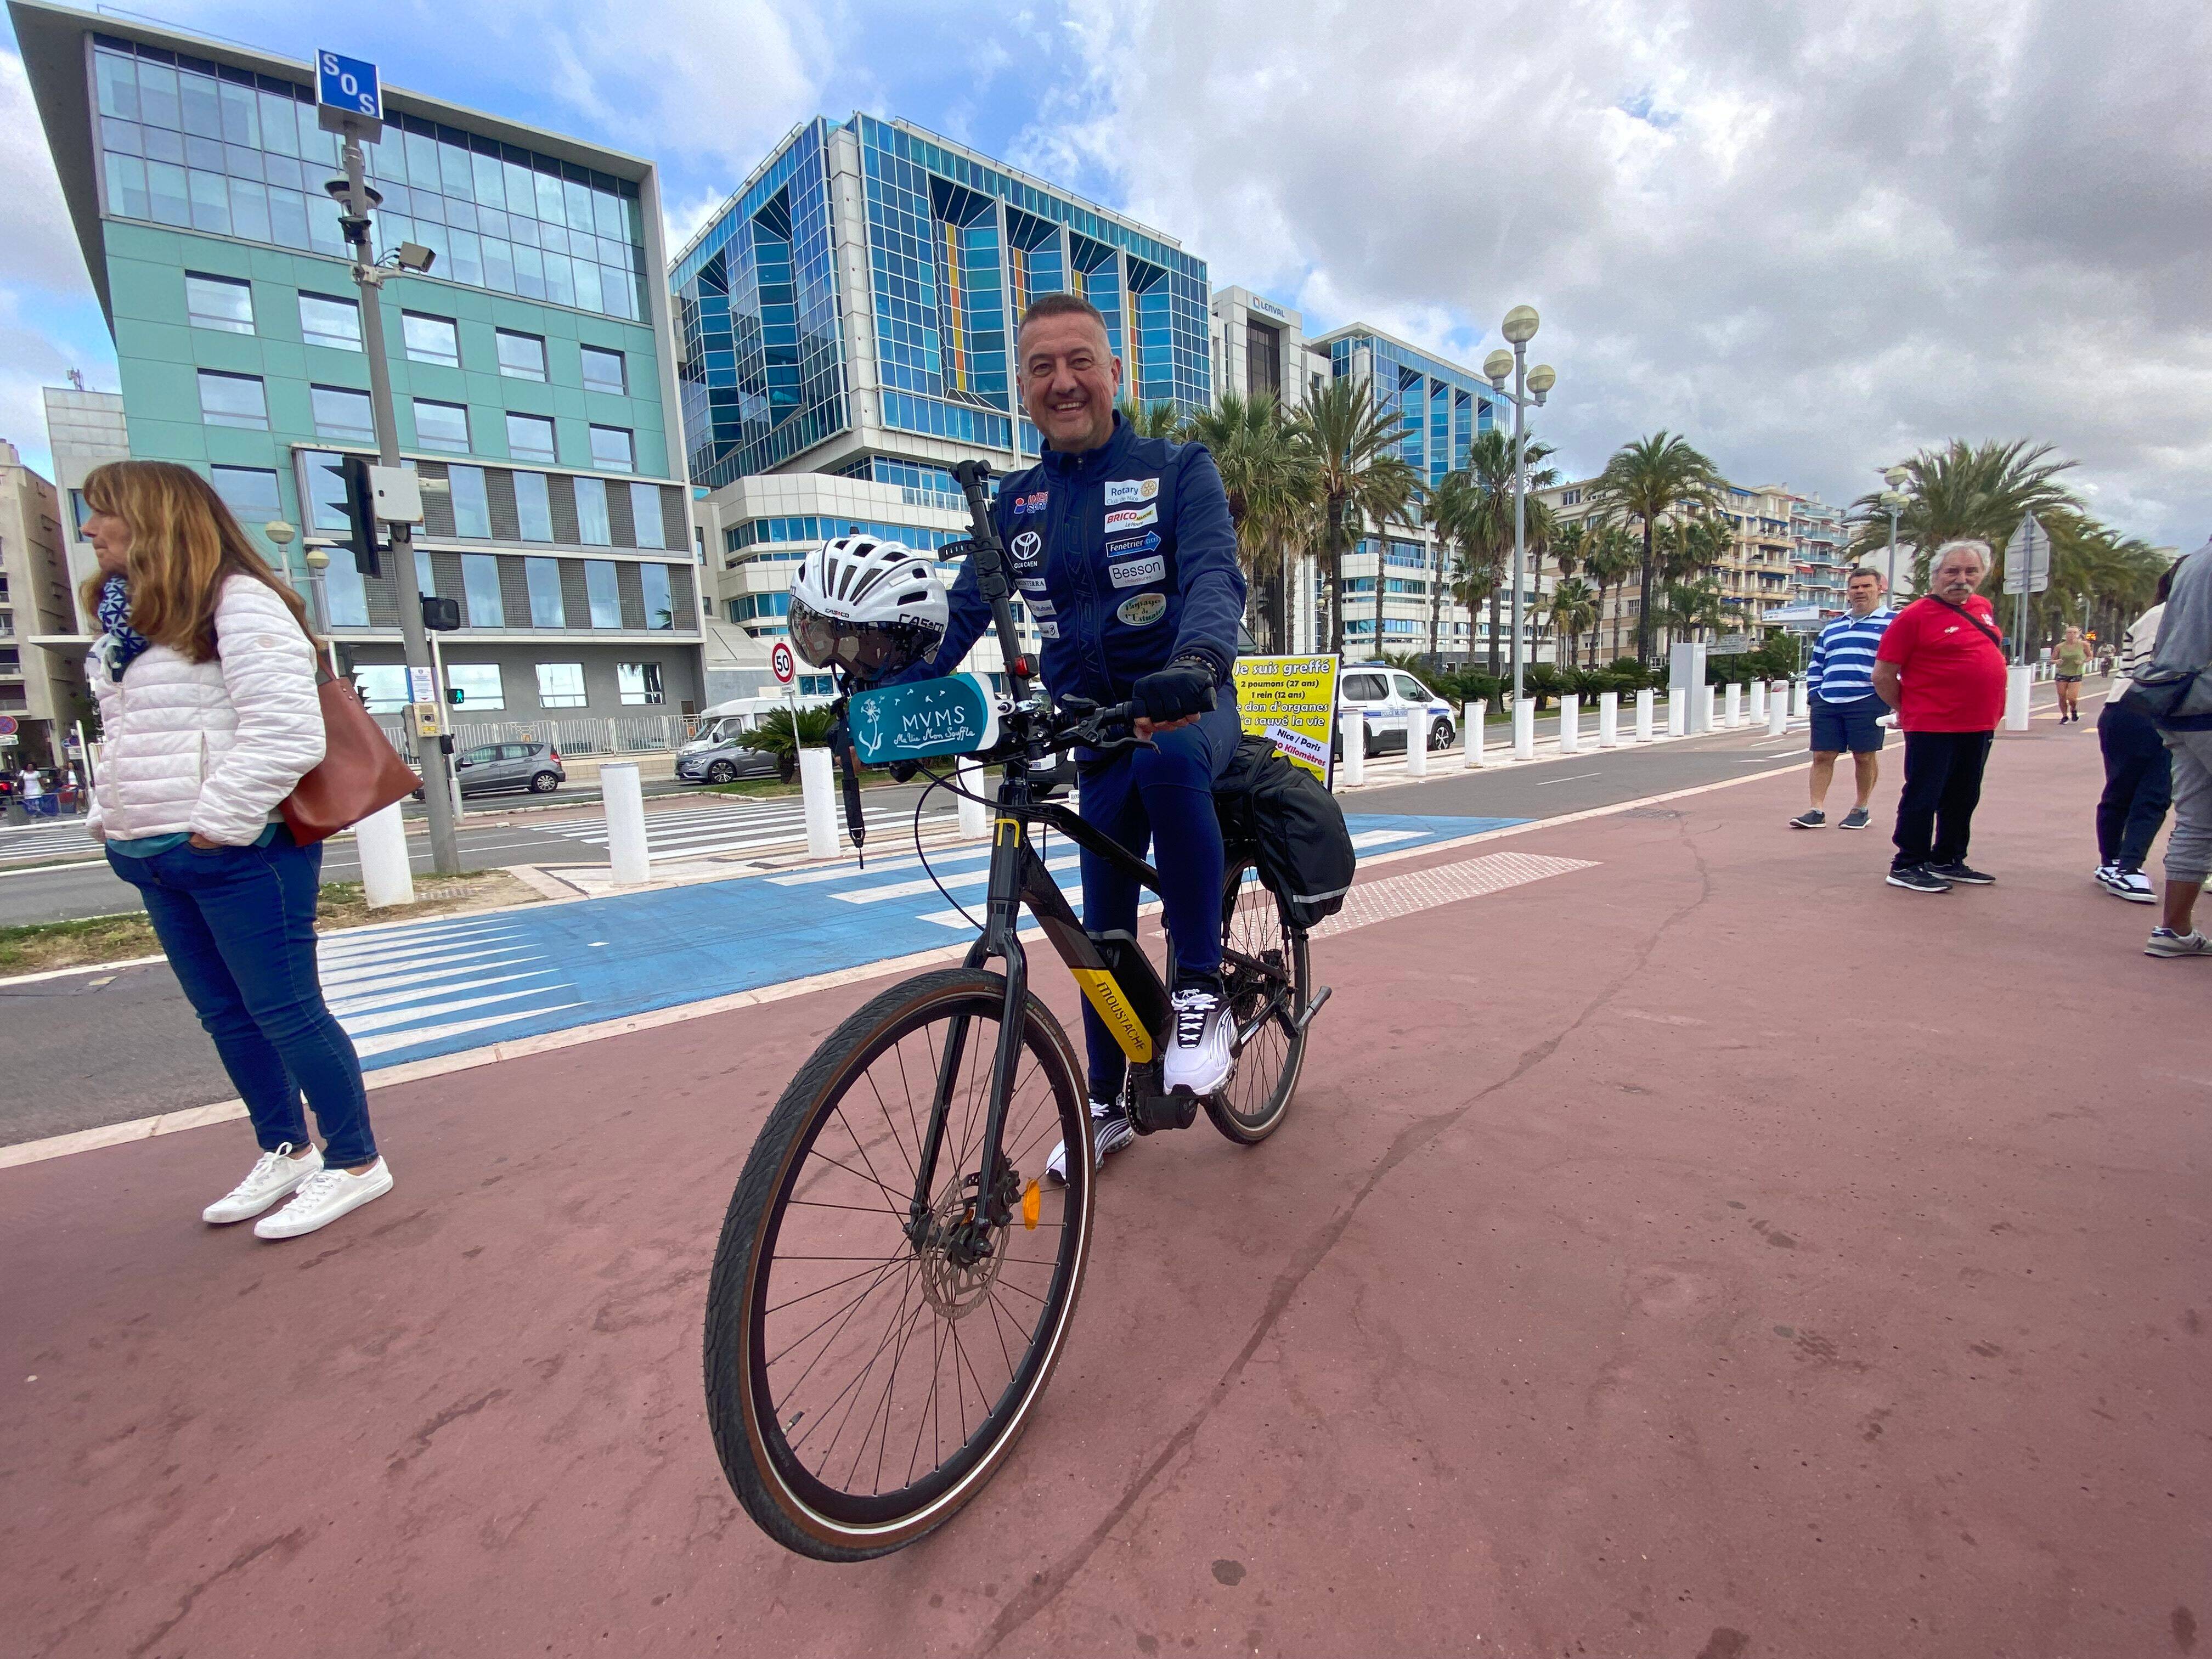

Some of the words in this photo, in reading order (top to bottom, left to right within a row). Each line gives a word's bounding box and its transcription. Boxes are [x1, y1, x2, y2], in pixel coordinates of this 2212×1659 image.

[323, 53, 376, 115] SOS
[1261, 301, 1285, 318] LENVAL
[1111, 487, 1138, 496] Rotary
[1107, 512, 1137, 524] BRICO
[1112, 562, 1160, 579] Besson
[776, 654, 789, 672] 50
[1234, 662, 1249, 676] Je
[1252, 661, 1279, 675] suis
[1283, 659, 1330, 676] greffé
[1248, 680, 1284, 689] poumons
[1286, 680, 1299, 689] (27
[1301, 679, 1319, 688] ans)
[1274, 691, 1286, 699] (12
[1288, 691, 1305, 699] ans)
[1235, 704, 1242, 712] e
[1244, 701, 1266, 712] don
[1269, 701, 1329, 713] d'organes
[902, 706, 964, 731] MVMS
[1240, 714, 1251, 725] 'a
[1254, 715, 1288, 726] sauvé
[1291, 715, 1303, 726] la
[1306, 716, 1325, 726] vie
[894, 733, 907, 744] Ma
[907, 732, 921, 742] Vie
[923, 727, 943, 741] Mon
[945, 726, 975, 741] Souffle
[1277, 729, 1294, 741] Nice
[1300, 738, 1321, 752] Paris
[1284, 744, 1326, 767] Kilomètres
[1097, 981, 1147, 1050] MOUSTACHE
